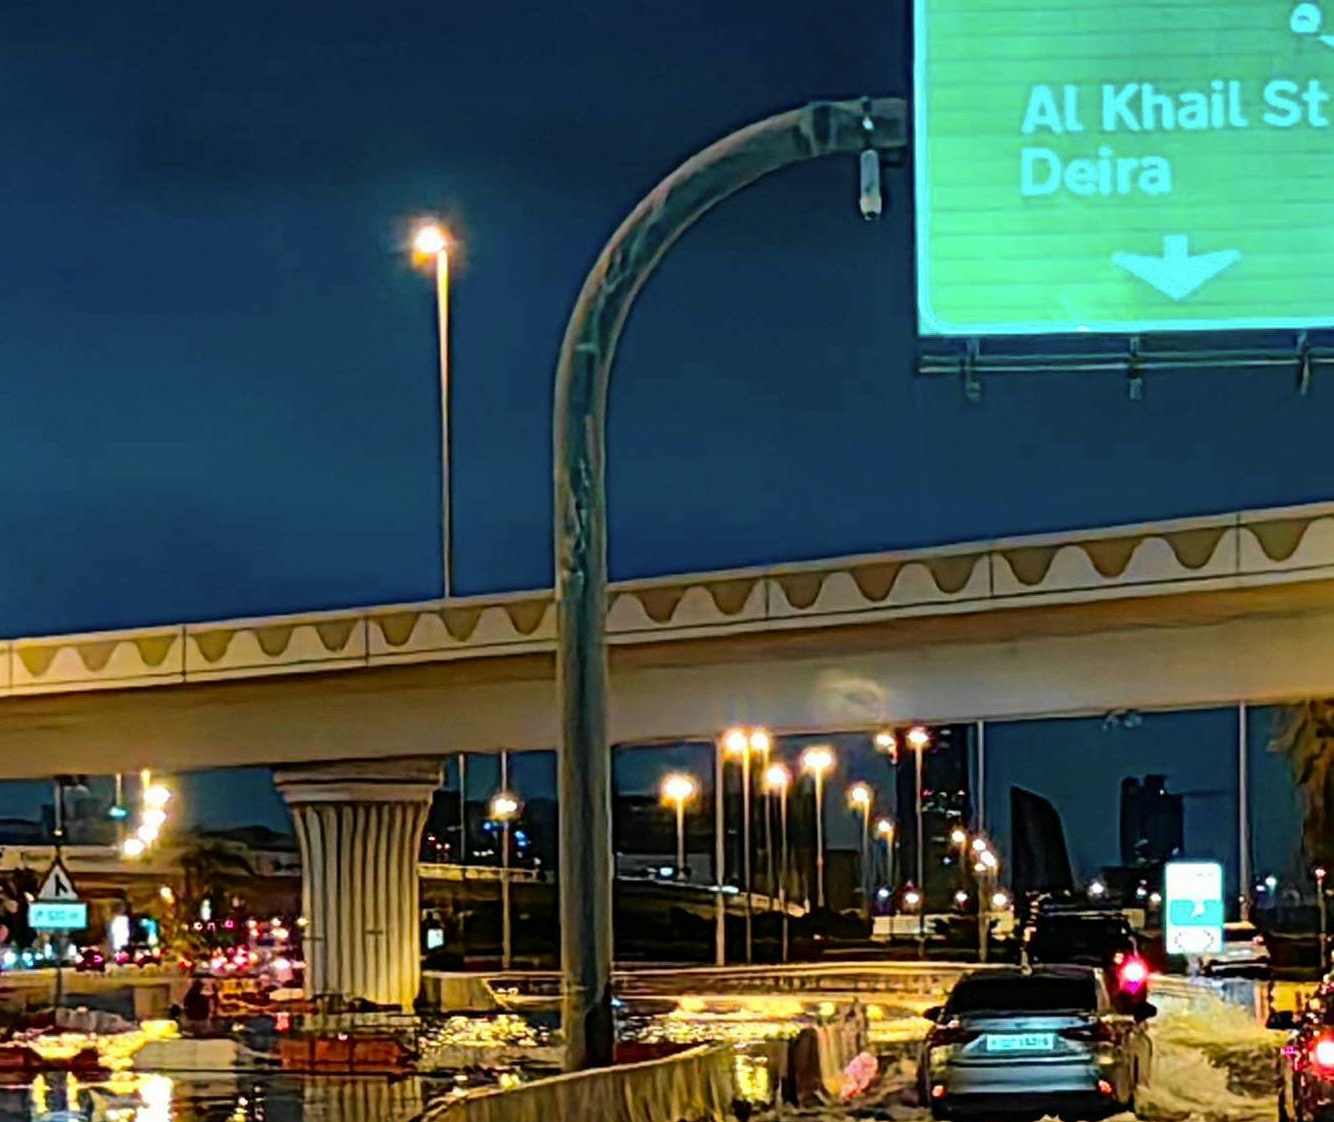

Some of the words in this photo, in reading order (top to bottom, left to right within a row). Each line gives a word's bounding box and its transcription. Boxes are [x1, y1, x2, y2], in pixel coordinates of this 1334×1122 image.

[1020, 84, 1084, 134] Al
[1102, 80, 1249, 131] Khail
[1262, 80, 1330, 127] St
[1020, 146, 1172, 196] Deira
